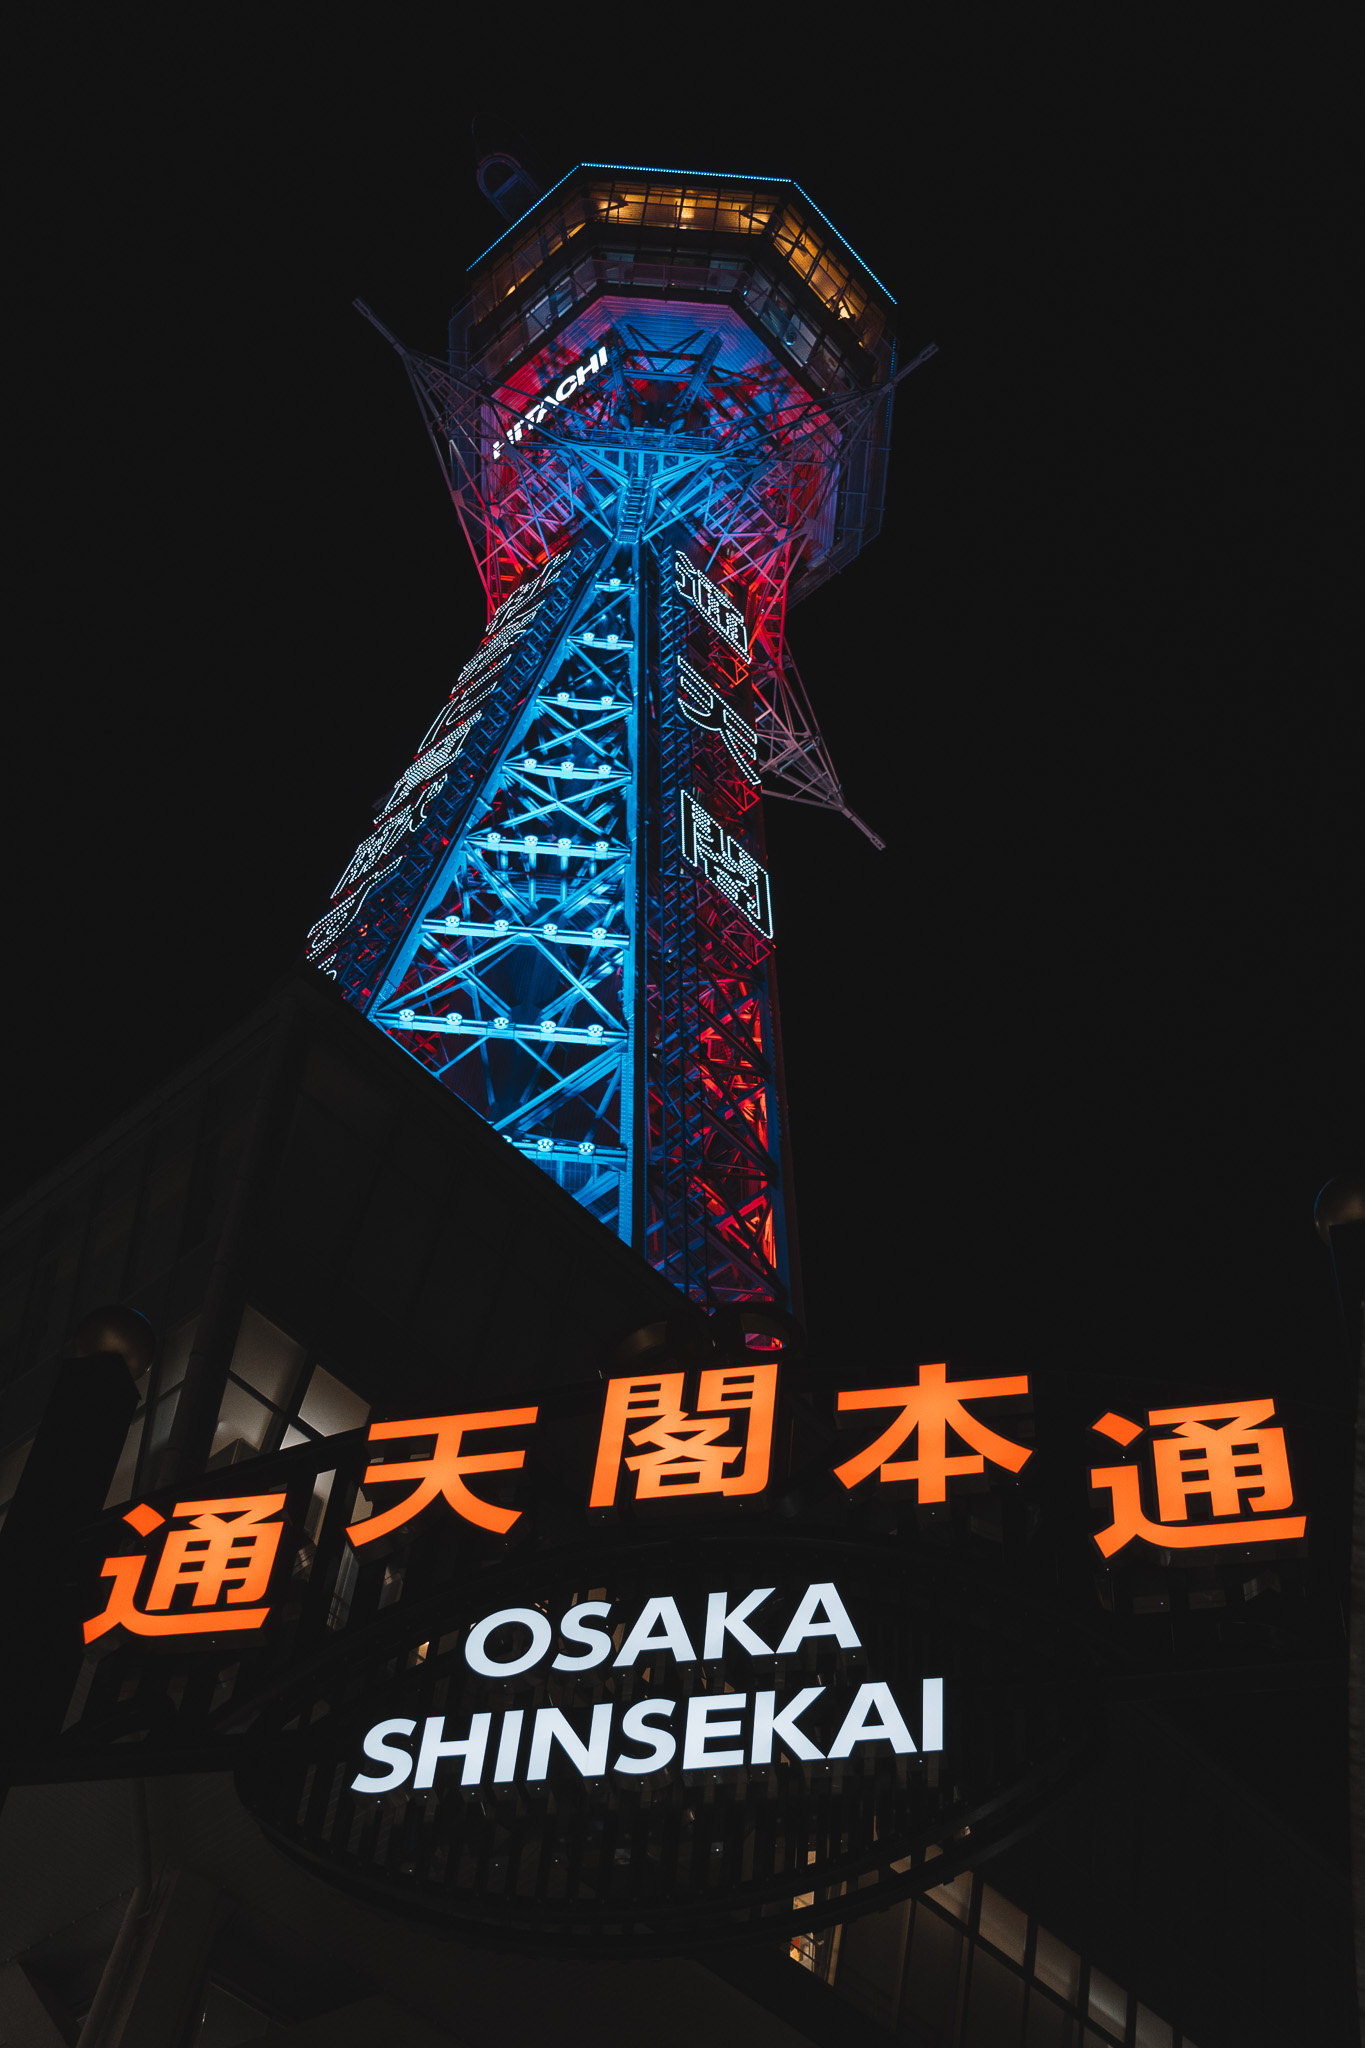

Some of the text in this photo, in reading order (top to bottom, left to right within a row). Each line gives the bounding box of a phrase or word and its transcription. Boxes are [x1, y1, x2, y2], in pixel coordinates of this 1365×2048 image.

[674, 549, 774, 940] 通天閣
[83, 1363, 1307, 1645] 通天閣本通
[465, 1582, 862, 1679] OSAKA
[351, 1677, 945, 1794] SHINSEKAI
